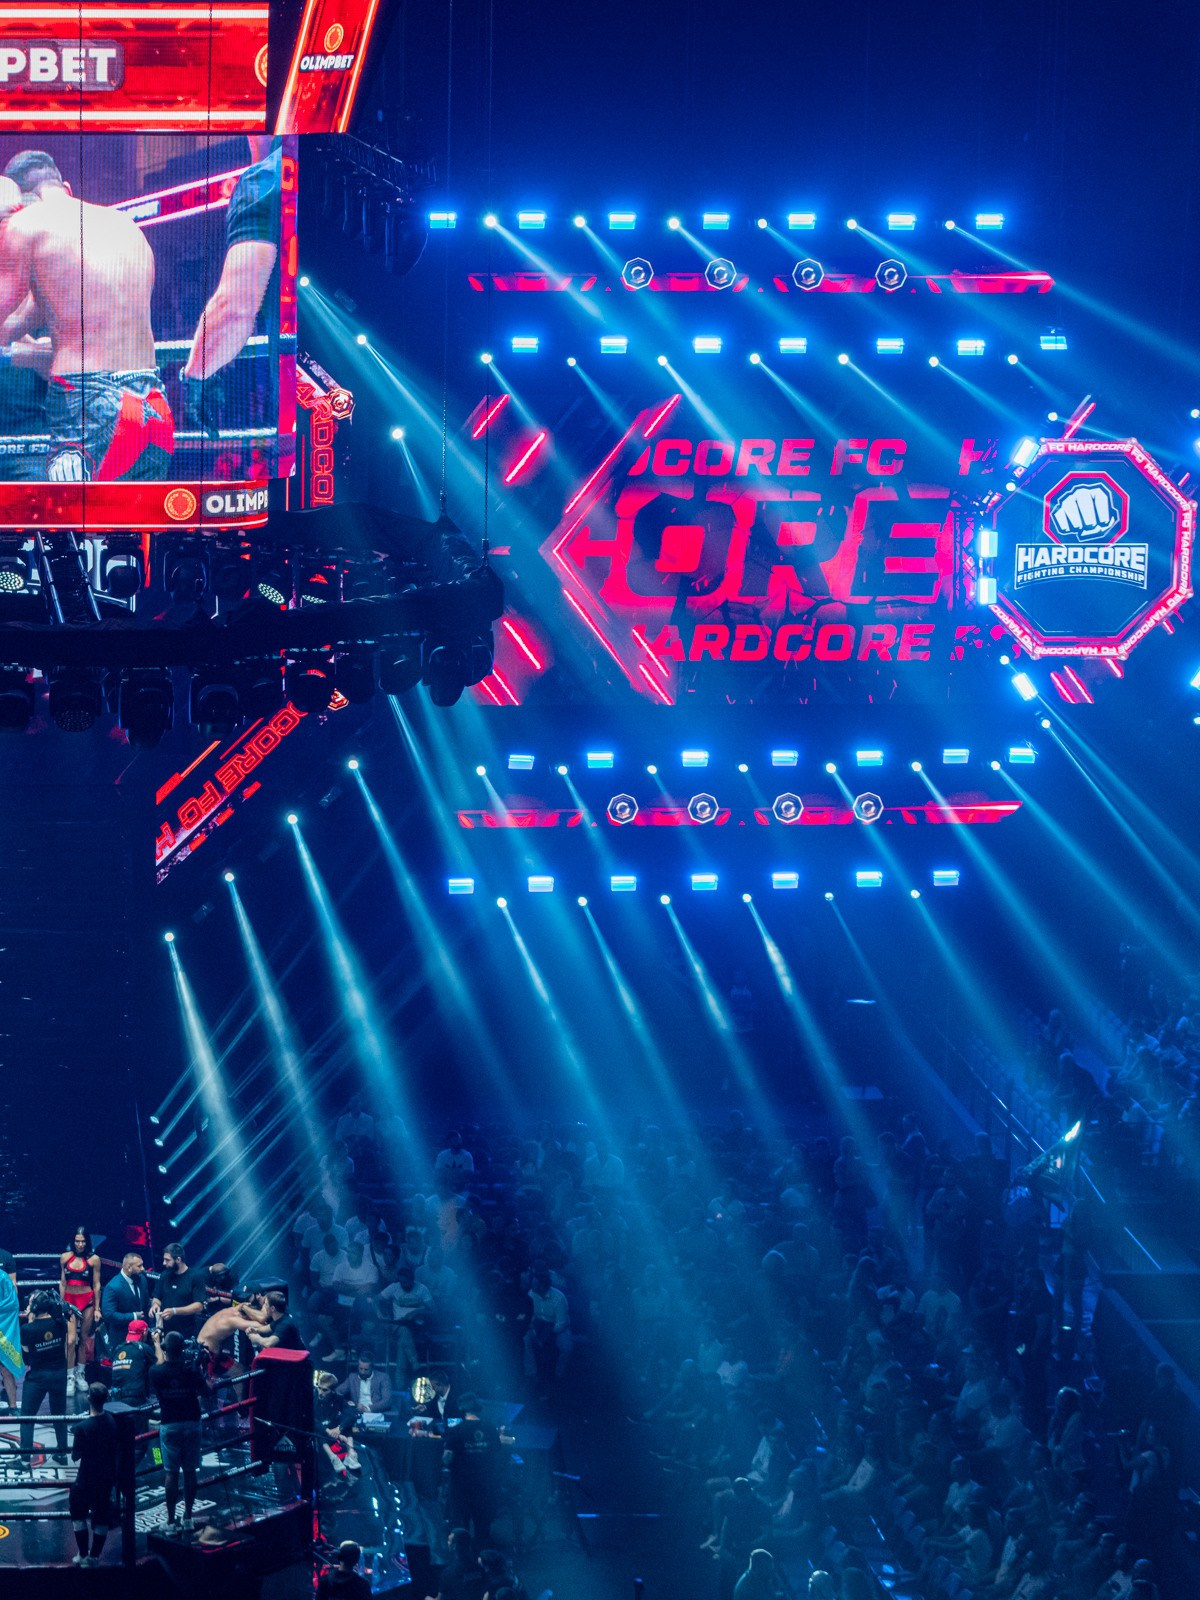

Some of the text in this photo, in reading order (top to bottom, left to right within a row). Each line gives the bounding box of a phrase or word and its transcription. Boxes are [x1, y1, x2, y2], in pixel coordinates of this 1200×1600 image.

[300, 54, 355, 71] OLIMPBET
[30, 443, 50, 454] FI
[830, 438, 908, 476] FC
[1049, 443, 1133, 452] FC HARDCORE
[1130, 447, 1191, 512] FC HARDCORE
[1017, 546, 1146, 572] HARDCORE
[1178, 511, 1193, 594] FC HARDCORE
[1017, 566, 1146, 583] FIGHTING CHAMPIONSHIP
[1119, 592, 1185, 653] FC HARDCORE
[1033, 646, 1119, 656] FC HARDCORE
[214, 700, 308, 794] CORE
[177, 780, 223, 831] FC
